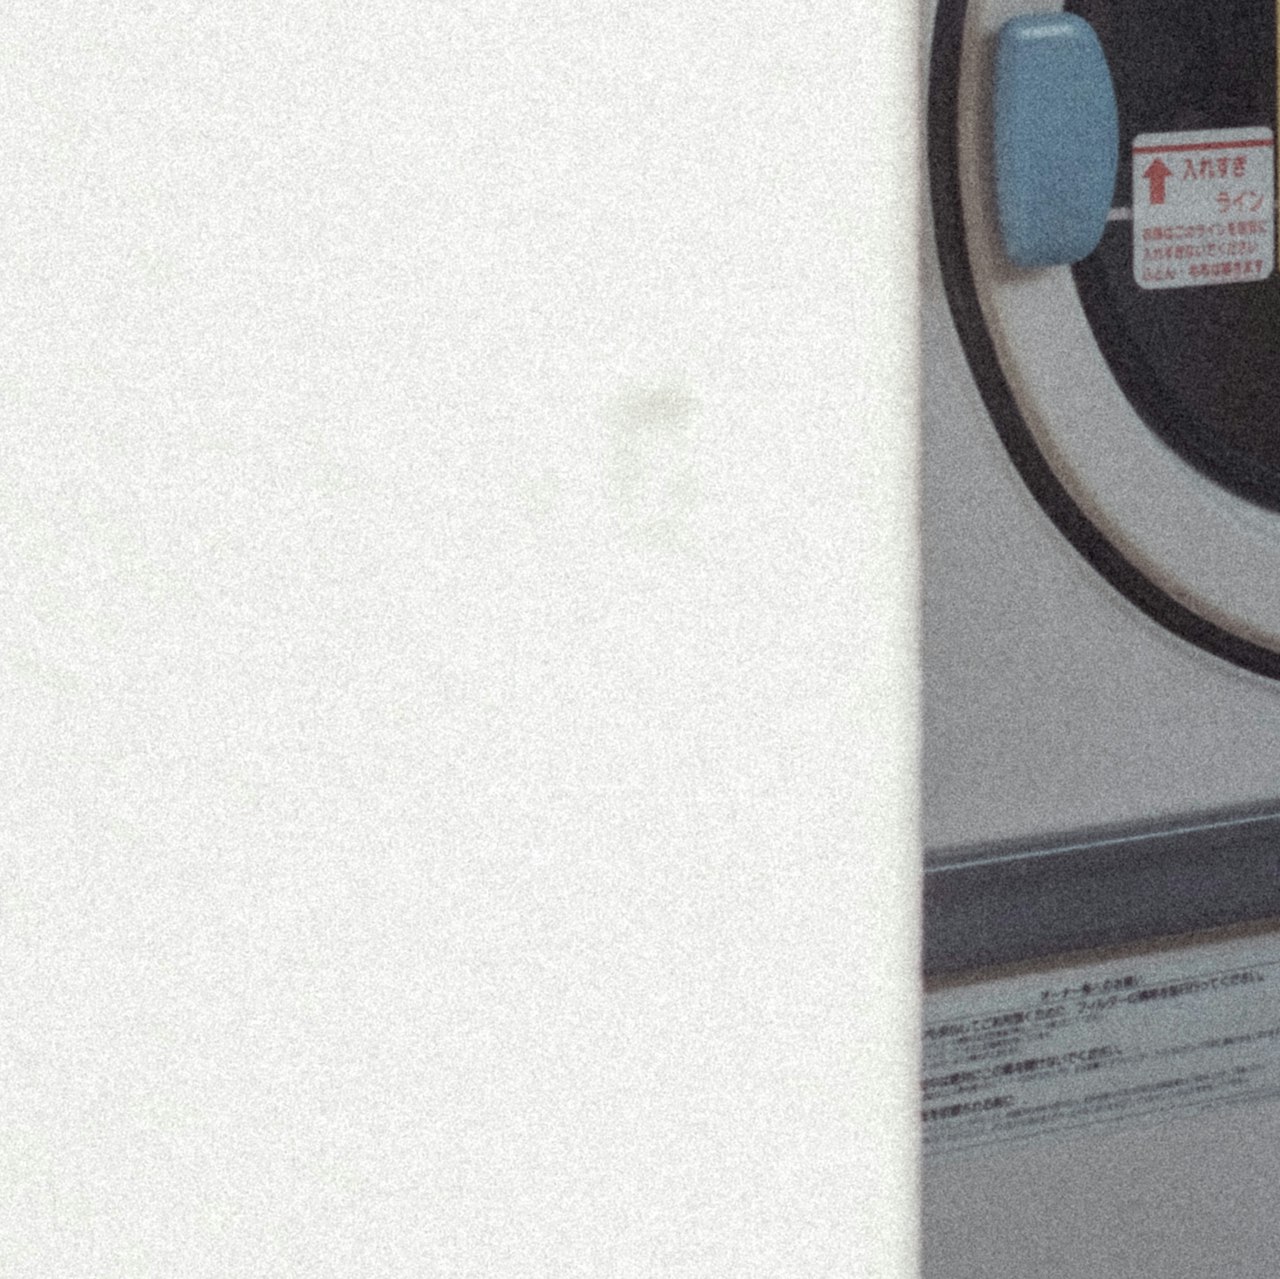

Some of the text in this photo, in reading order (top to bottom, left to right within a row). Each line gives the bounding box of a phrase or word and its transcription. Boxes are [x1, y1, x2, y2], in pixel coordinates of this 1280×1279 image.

[1183, 155, 1247, 181] 入れすぎ
[1216, 191, 1264, 214] ライン
